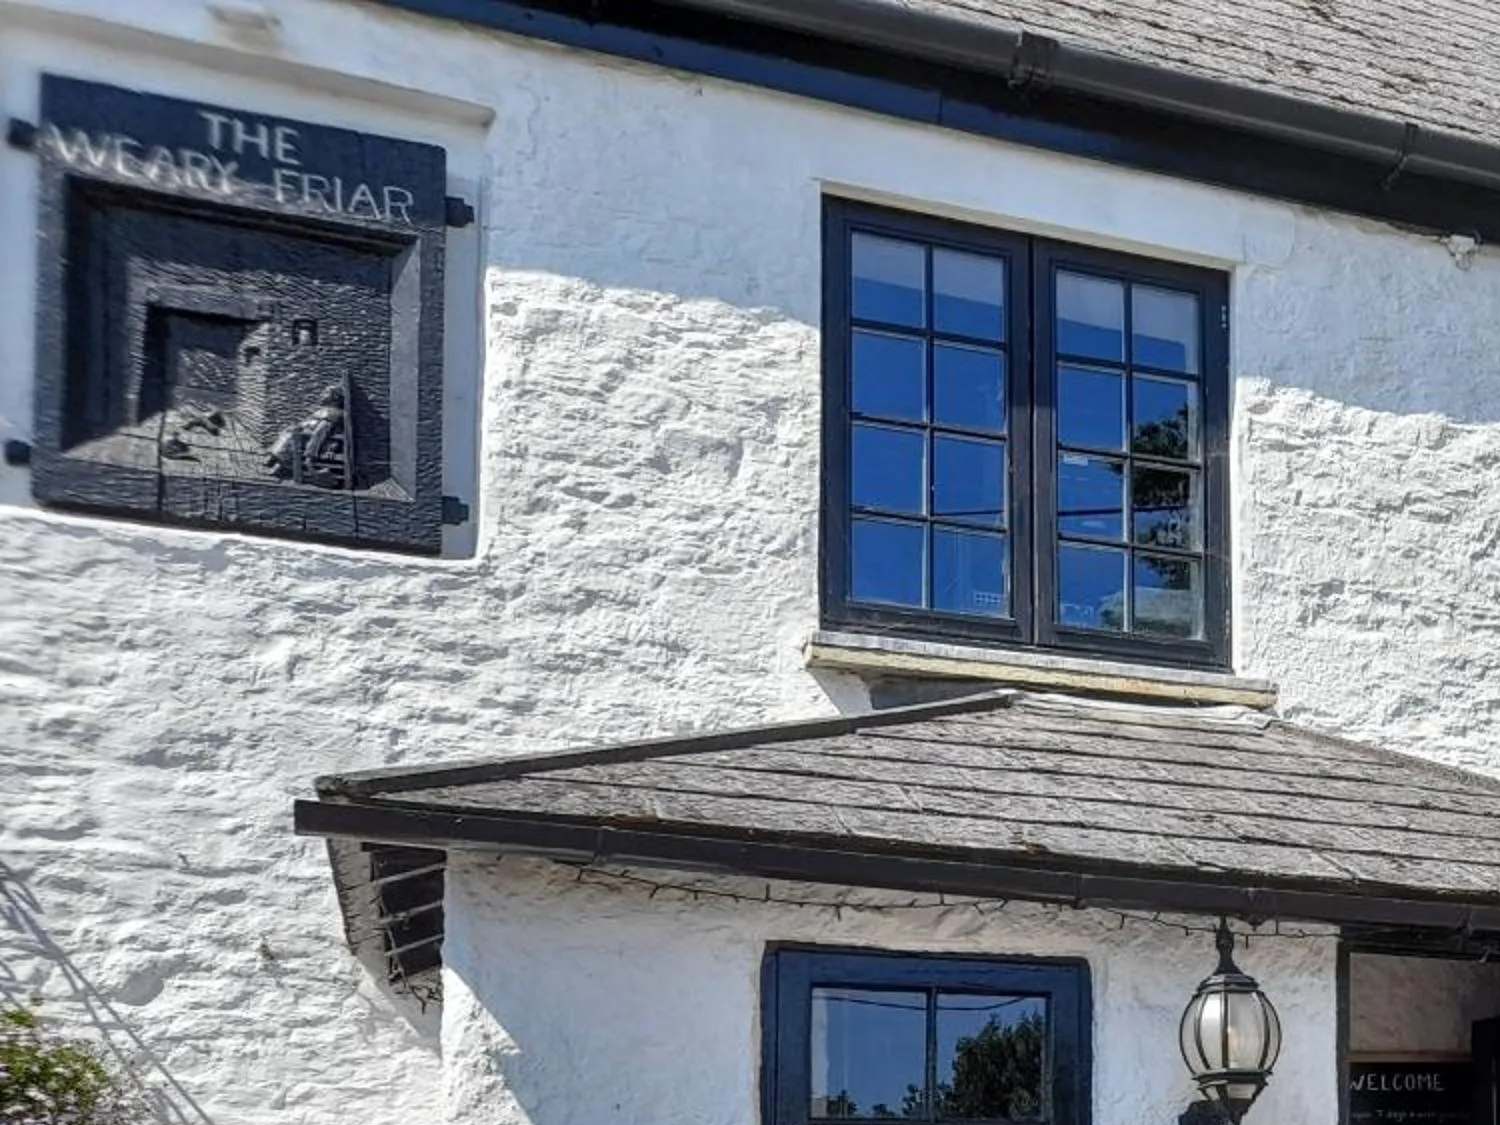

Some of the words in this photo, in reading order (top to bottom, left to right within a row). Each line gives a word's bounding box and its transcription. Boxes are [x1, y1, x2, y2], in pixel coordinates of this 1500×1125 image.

[200, 111, 302, 165] THE
[44, 122, 239, 196] WEARY
[273, 168, 414, 226] FRIAR
[1350, 1073, 1444, 1092] WELCOME
